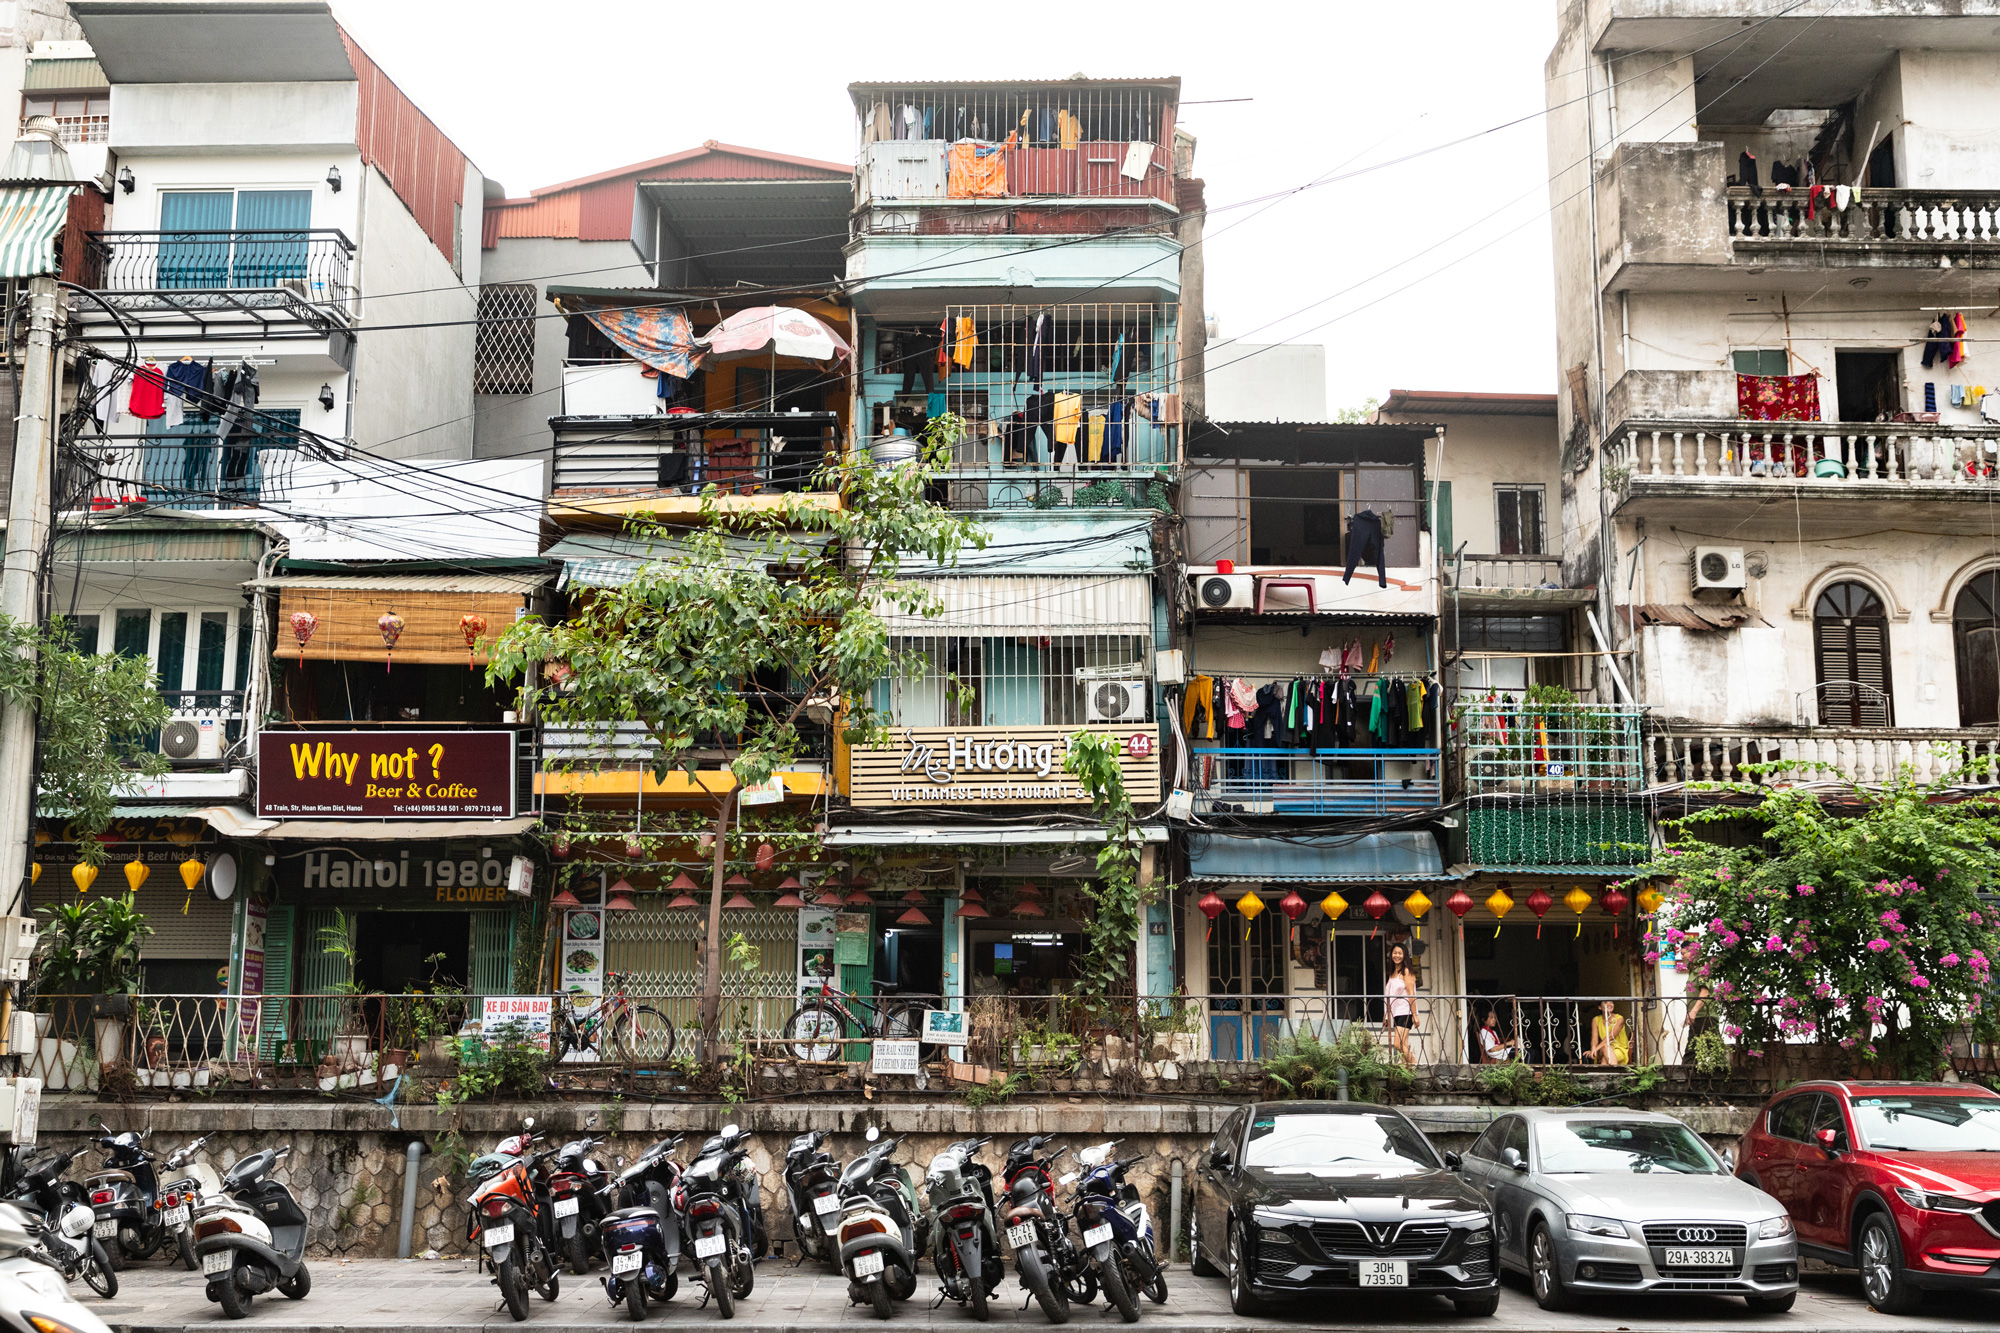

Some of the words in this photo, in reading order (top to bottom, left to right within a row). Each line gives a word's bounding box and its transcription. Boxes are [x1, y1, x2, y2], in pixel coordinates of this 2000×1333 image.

[781, 325, 818, 335] EXPERT
[1130, 736, 1149, 750] 44
[901, 728, 952, 784] Ms
[947, 737, 1053, 778] Hương
[290, 742, 359, 786] Why
[371, 747, 419, 780] not
[428, 743, 445, 780] ?
[1549, 765, 1561, 775] 40
[365, 783, 402, 798] Beer
[406, 783, 421, 798] &
[425, 783, 479, 798] Coffee
[891, 786, 974, 801] VIETNAMESE
[980, 784, 1069, 800] RESTAURANT
[1074, 788, 1084, 798] &
[264, 804, 273, 812] 48
[273, 804, 290, 813] Train,
[290, 804, 301, 813] Str,
[332, 804, 346, 813] Dist,
[393, 804, 405, 812] Tel:
[405, 804, 421, 813] (+84)
[421, 804, 436, 812] 0985
[436, 804, 448, 812] 248
[147, 852, 169, 861] Beef
[170, 852, 201, 861] Noodle
[303, 850, 409, 889] Hanoi
[436, 887, 506, 902] FLOWER
[1353, 907, 1365, 917] 42
[1152, 924, 1164, 934] 44
[486, 1001, 498, 1013] XE
[500, 1001, 509, 1013] ĐI
[511, 998, 530, 1013] SÂN
[532, 1001, 549, 1013] BAY
[876, 1044, 886, 1055] THE
[886, 1044, 897, 1055] RAIL
[898, 1045, 917, 1056] STREET
[874, 1058, 880, 1069] LE
[880, 1058, 899, 1070] CHEMIN
[900, 1058, 907, 1070] DE
[907, 1059, 917, 1070] FER
[1013, 1232, 1034, 1246] 1016
[206, 1252, 228, 1264] 29-H6
[1667, 1250, 1732, 1264] 29A-383.24
[206, 1261, 227, 1273] 4927
[859, 1263, 880, 1275] 2608
[1373, 1262, 1394, 1273] 30H
[1364, 1274, 1403, 1285] 739.50
